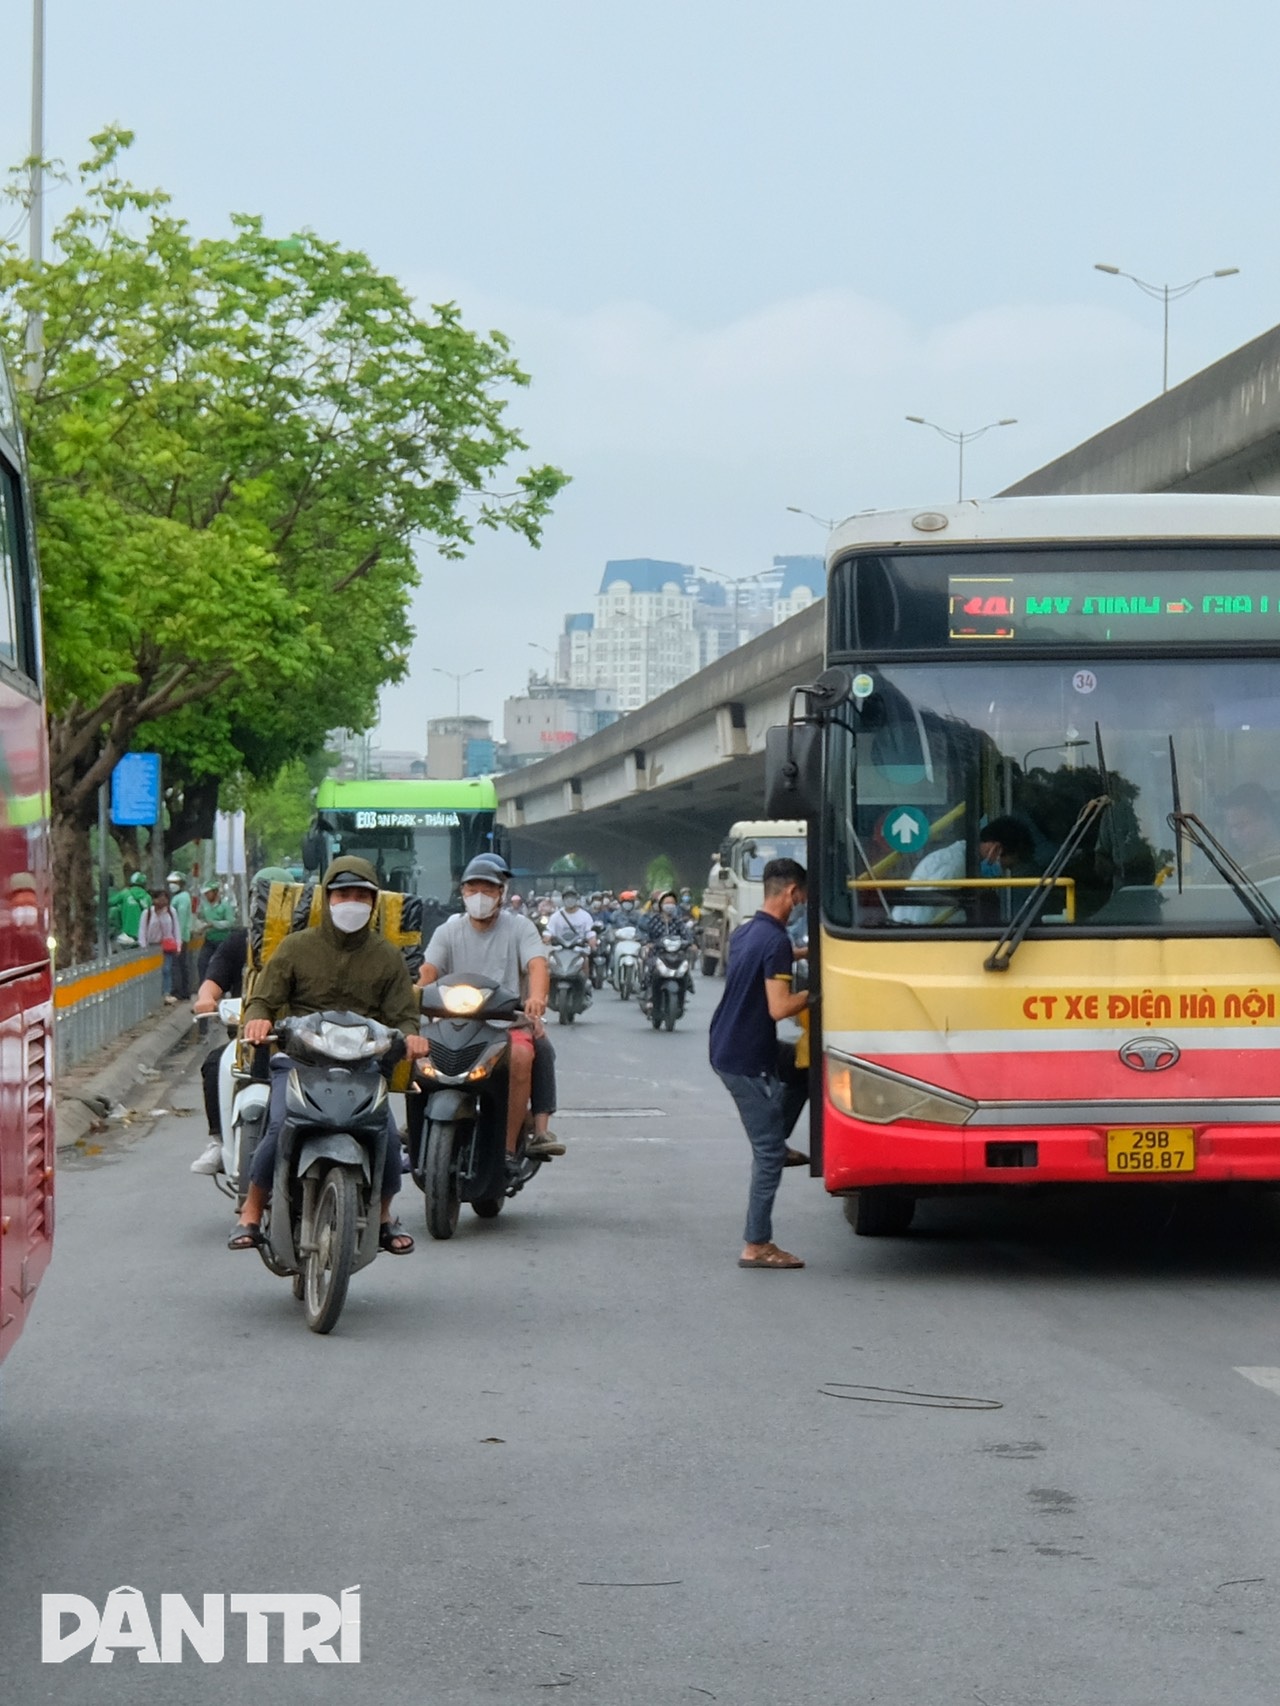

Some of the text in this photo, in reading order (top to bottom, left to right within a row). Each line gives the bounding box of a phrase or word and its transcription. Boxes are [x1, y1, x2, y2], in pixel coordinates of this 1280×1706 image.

[1075, 673, 1094, 690] 34
[356, 811, 377, 829] E03
[391, 813, 416, 827] PARK
[1023, 987, 1275, 1027] CT XE ĐIỆN HÀ NỘI
[1132, 1131, 1169, 1149] 29B
[1117, 1151, 1185, 1169] 058.87
